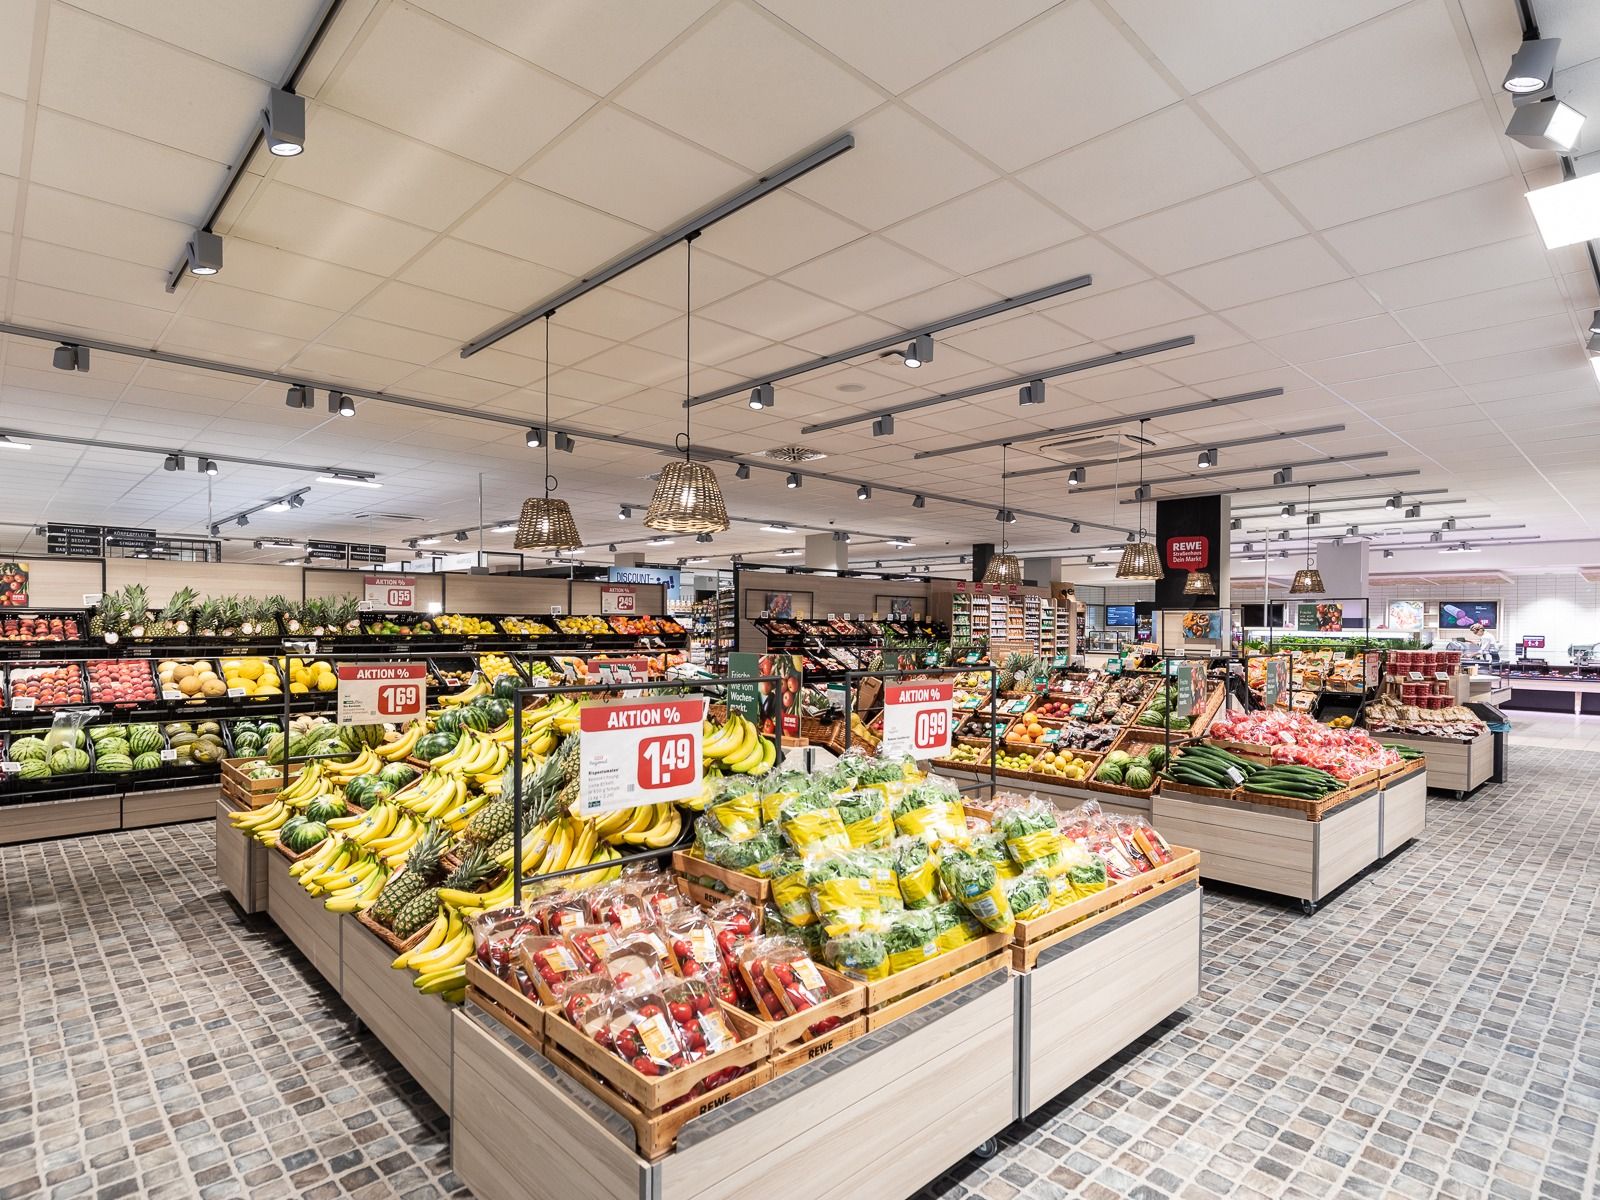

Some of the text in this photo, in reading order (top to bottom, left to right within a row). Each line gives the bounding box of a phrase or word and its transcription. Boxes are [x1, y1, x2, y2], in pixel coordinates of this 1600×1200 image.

[1172, 541, 1202, 551] REWE
[375, 578, 397, 586] AKTION
[389, 590, 410, 605] 0.55
[357, 668, 410, 679] AKTION %
[731, 683, 754, 691] wie vom
[382, 686, 416, 713] 1.69
[730, 691, 755, 702] Wochen-
[899, 688, 941, 703] AKTION %
[608, 707, 680, 728] AKTION %
[917, 712, 946, 746] 0.99
[643, 738, 690, 785] 1.49
[808, 1040, 834, 1060] REWE
[699, 1093, 731, 1116] REWE
